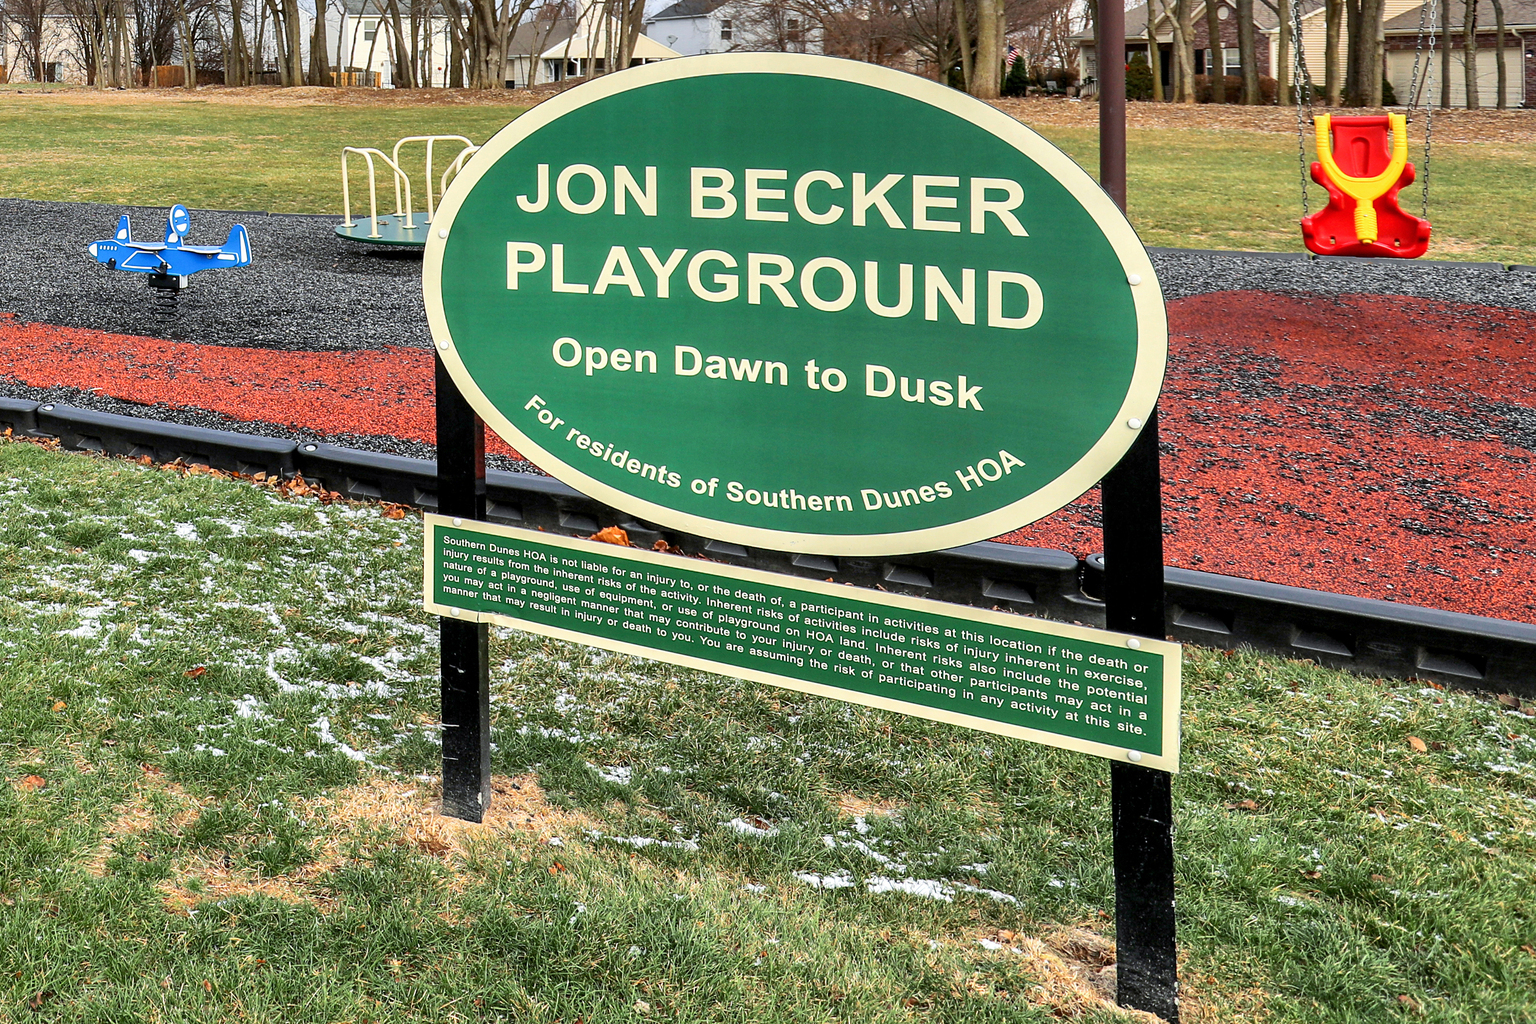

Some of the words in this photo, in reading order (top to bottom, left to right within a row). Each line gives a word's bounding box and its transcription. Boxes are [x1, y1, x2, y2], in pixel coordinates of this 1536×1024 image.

[516, 164, 657, 216] JON
[691, 167, 1029, 236] BECKER
[507, 242, 1043, 329] PLAYGROUND
[553, 337, 656, 376] Open
[675, 345, 787, 385] Dawn
[805, 359, 847, 392] to
[866, 364, 983, 411] Dusk
[524, 395, 564, 430] For
[566, 428, 681, 487] residents
[691, 478, 719, 497] of
[726, 482, 853, 511] Southern
[861, 482, 952, 510] Dunes
[955, 450, 1025, 491] HOA
[442, 573, 460, 583] you
[464, 577, 484, 589] may
[488, 581, 504, 591] act
[507, 583, 516, 593] in
[520, 587, 527, 595] a
[531, 589, 577, 606] negligent
[580, 600, 620, 614] manner
[623, 607, 644, 620] that
[648, 613, 671, 627] may
[675, 619, 731, 637] contribute
[735, 629, 747, 640] to
[751, 634, 777, 646] your
[782, 638, 815, 656] injury
[819, 648, 833, 657] or
[837, 650, 875, 667] death,
[881, 660, 895, 669] or
[900, 662, 925, 676] that
[930, 669, 964, 683] other
[970, 677, 1048, 700] participants
[1055, 694, 1084, 709] may
[1090, 701, 1112, 714] act
[1118, 705, 1131, 718] in
[1138, 711, 1148, 721] a
[443, 535, 486, 551] Southern
[489, 543, 520, 557] Dunes
[523, 549, 547, 562] HOA
[549, 554, 559, 564] is
[561, 558, 578, 568] not
[581, 560, 609, 574] liable
[611, 566, 627, 577] for
[629, 571, 643, 580] an
[646, 572, 677, 588] injury
[679, 578, 694, 591] to,
[697, 583, 710, 592] or
[712, 585, 731, 597] the
[734, 589, 766, 603] death
[770, 596, 785, 608] of,
[789, 600, 797, 609] a
[800, 602, 864, 622] participant
[868, 612, 879, 624] in
[883, 617, 940, 635] activities
[944, 628, 957, 639] at
[961, 630, 985, 643] this
[989, 634, 1042, 654] location
[1047, 645, 1057, 657] if
[1061, 648, 1083, 662] the
[1088, 653, 1128, 670] death
[1133, 663, 1149, 674] or
[443, 547, 470, 562] injury
[472, 554, 505, 567] results
[507, 558, 530, 571] from
[533, 564, 550, 575] the
[553, 567, 594, 584] inherent
[597, 576, 622, 589] risks
[625, 582, 637, 592] of
[639, 584, 657, 596] the
[660, 590, 702, 606] activity.
[706, 596, 753, 615] Inherent
[756, 607, 784, 620] risks
[788, 613, 800, 623] of
[804, 617, 857, 634] activities
[861, 625, 906, 643] include
[910, 635, 941, 650] risks
[945, 643, 959, 653] of
[963, 644, 1000, 663] injury
[1005, 652, 1061, 673] inherent
[1066, 663, 1078, 676] in
[1083, 669, 1148, 691] exercise,
[443, 561, 473, 573] nature
[476, 566, 487, 576] of
[490, 570, 497, 578] a
[501, 571, 558, 590] playground,
[562, 583, 581, 594] use
[584, 587, 596, 597] of
[599, 591, 657, 610] equipment,
[661, 603, 674, 612] or
[677, 606, 698, 617] use
[702, 610, 714, 620] of
[718, 613, 780, 633] playground
[785, 627, 800, 637] on
[806, 629, 834, 644] HOA
[839, 635, 869, 651] land.
[875, 642, 927, 662] Inherent
[933, 654, 963, 669] risks
[969, 662, 997, 675] also
[1003, 666, 1052, 686] include
[1058, 678, 1080, 692] the
[1086, 685, 1148, 705] potential
[443, 585, 479, 599] manner
[482, 591, 502, 603] that
[505, 597, 526, 609] may
[529, 602, 557, 614] result
[561, 606, 570, 617] in
[574, 609, 603, 625] injury
[607, 618, 619, 627] or
[622, 620, 652, 634] death
[656, 627, 667, 637] to
[671, 631, 695, 643] you.
[699, 635, 721, 648] You
[725, 642, 744, 653] are
[749, 647, 804, 668] assuming
[809, 658, 828, 670] the
[833, 663, 856, 676] risk
[861, 669, 874, 680] of
[878, 673, 956, 699] participating
[962, 688, 974, 700] in
[980, 694, 1005, 708] any
[1010, 700, 1059, 720] activity
[1065, 711, 1079, 722] at
[1085, 714, 1111, 729] this
[1117, 721, 1147, 736] site.
